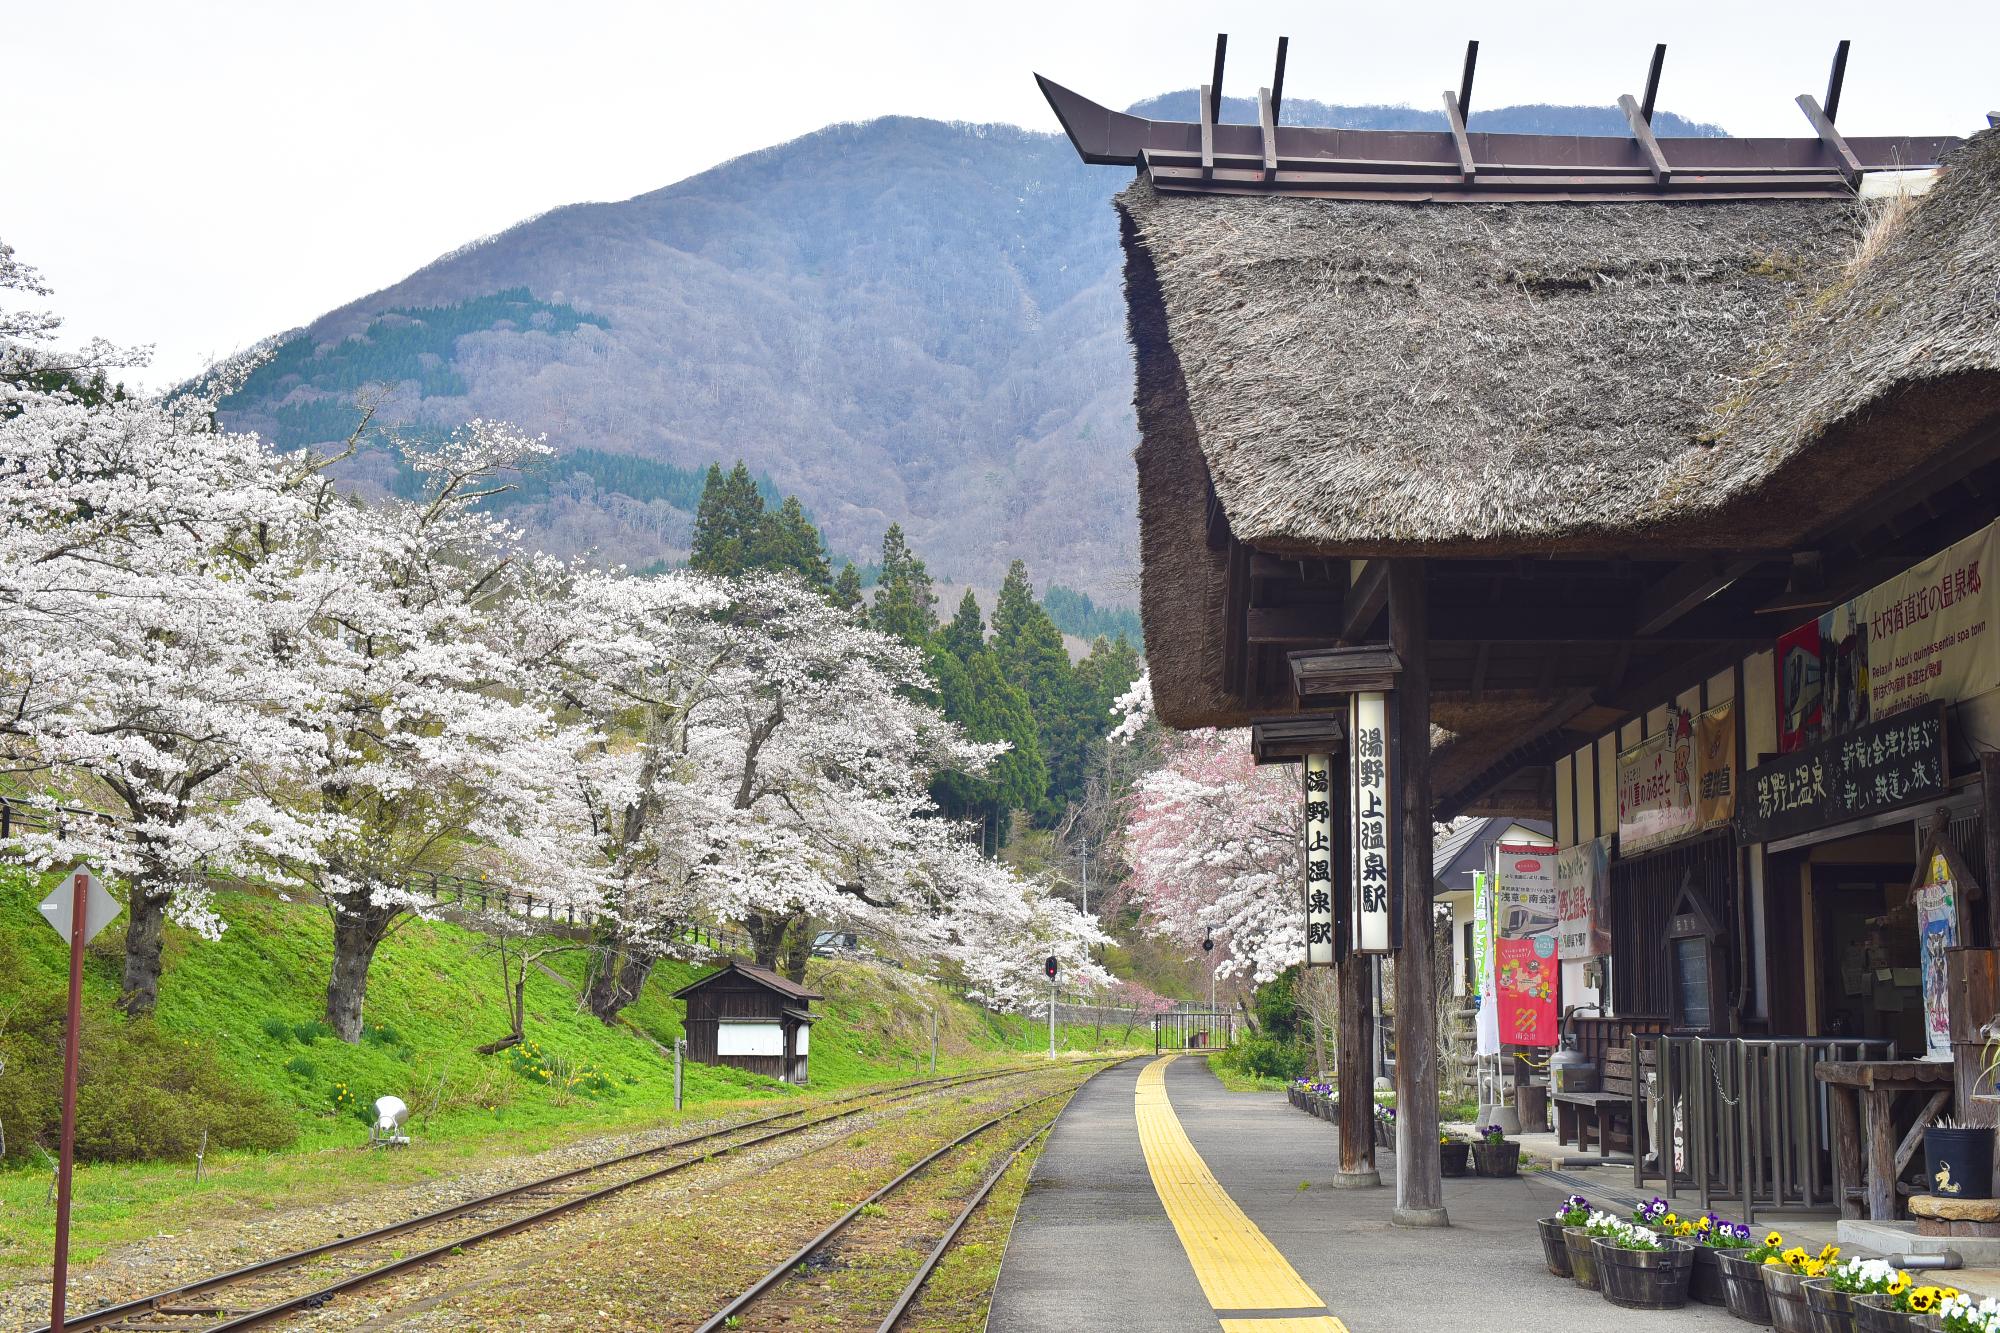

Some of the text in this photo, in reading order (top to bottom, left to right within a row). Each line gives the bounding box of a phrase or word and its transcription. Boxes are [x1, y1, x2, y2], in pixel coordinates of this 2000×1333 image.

[1871, 560, 1982, 643] 大内宿直近の温泉郷
[1895, 652, 1913, 669] Aizu's
[1957, 629, 1970, 644] spa
[1971, 621, 1986, 637] town
[1758, 756, 1827, 819] 湯野上温泉
[1844, 760, 1931, 810] 新しい鉄道の旅
[1360, 727, 1387, 913] 湯野上温泉駅
[1308, 770, 1332, 945] 湯野上温泉駅
[1501, 892, 1556, 904] 浅草 南会津
